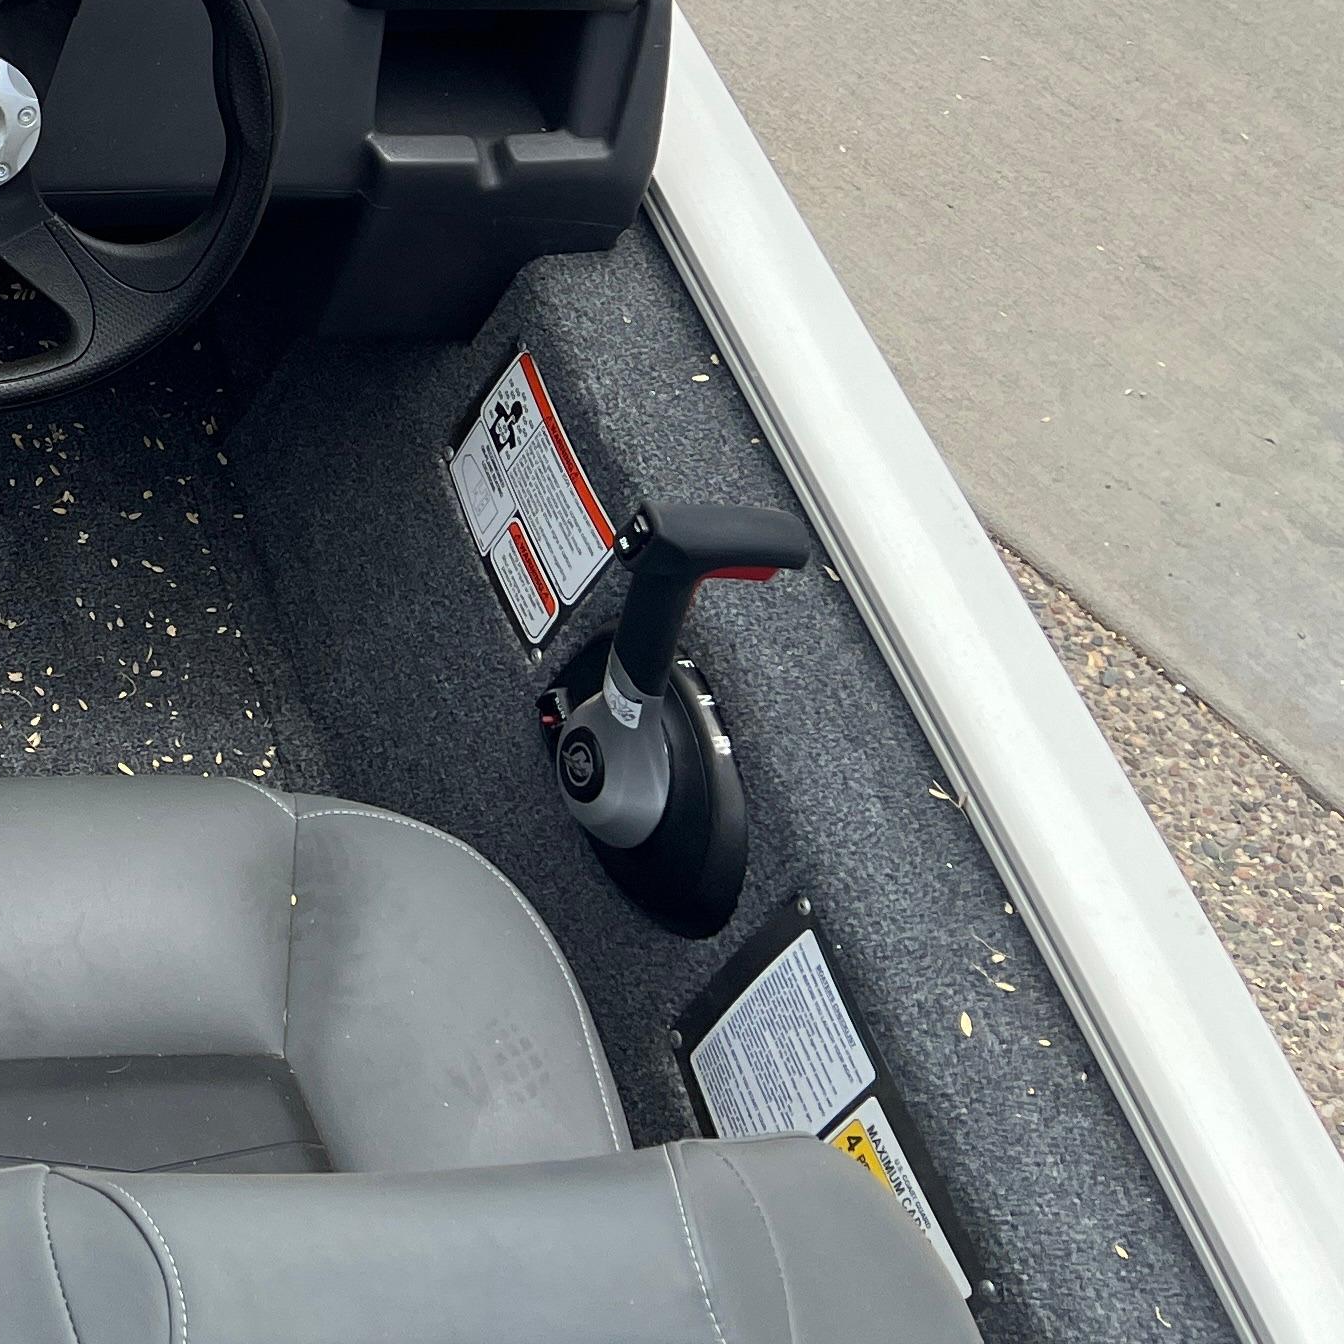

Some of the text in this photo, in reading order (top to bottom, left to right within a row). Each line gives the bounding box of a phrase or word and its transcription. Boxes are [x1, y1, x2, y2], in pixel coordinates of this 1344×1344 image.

[677, 659, 695, 668] F
[697, 694, 715, 706] N
[846, 1135, 863, 1152] 4
[864, 1123, 908, 1196] MAXIMUM
